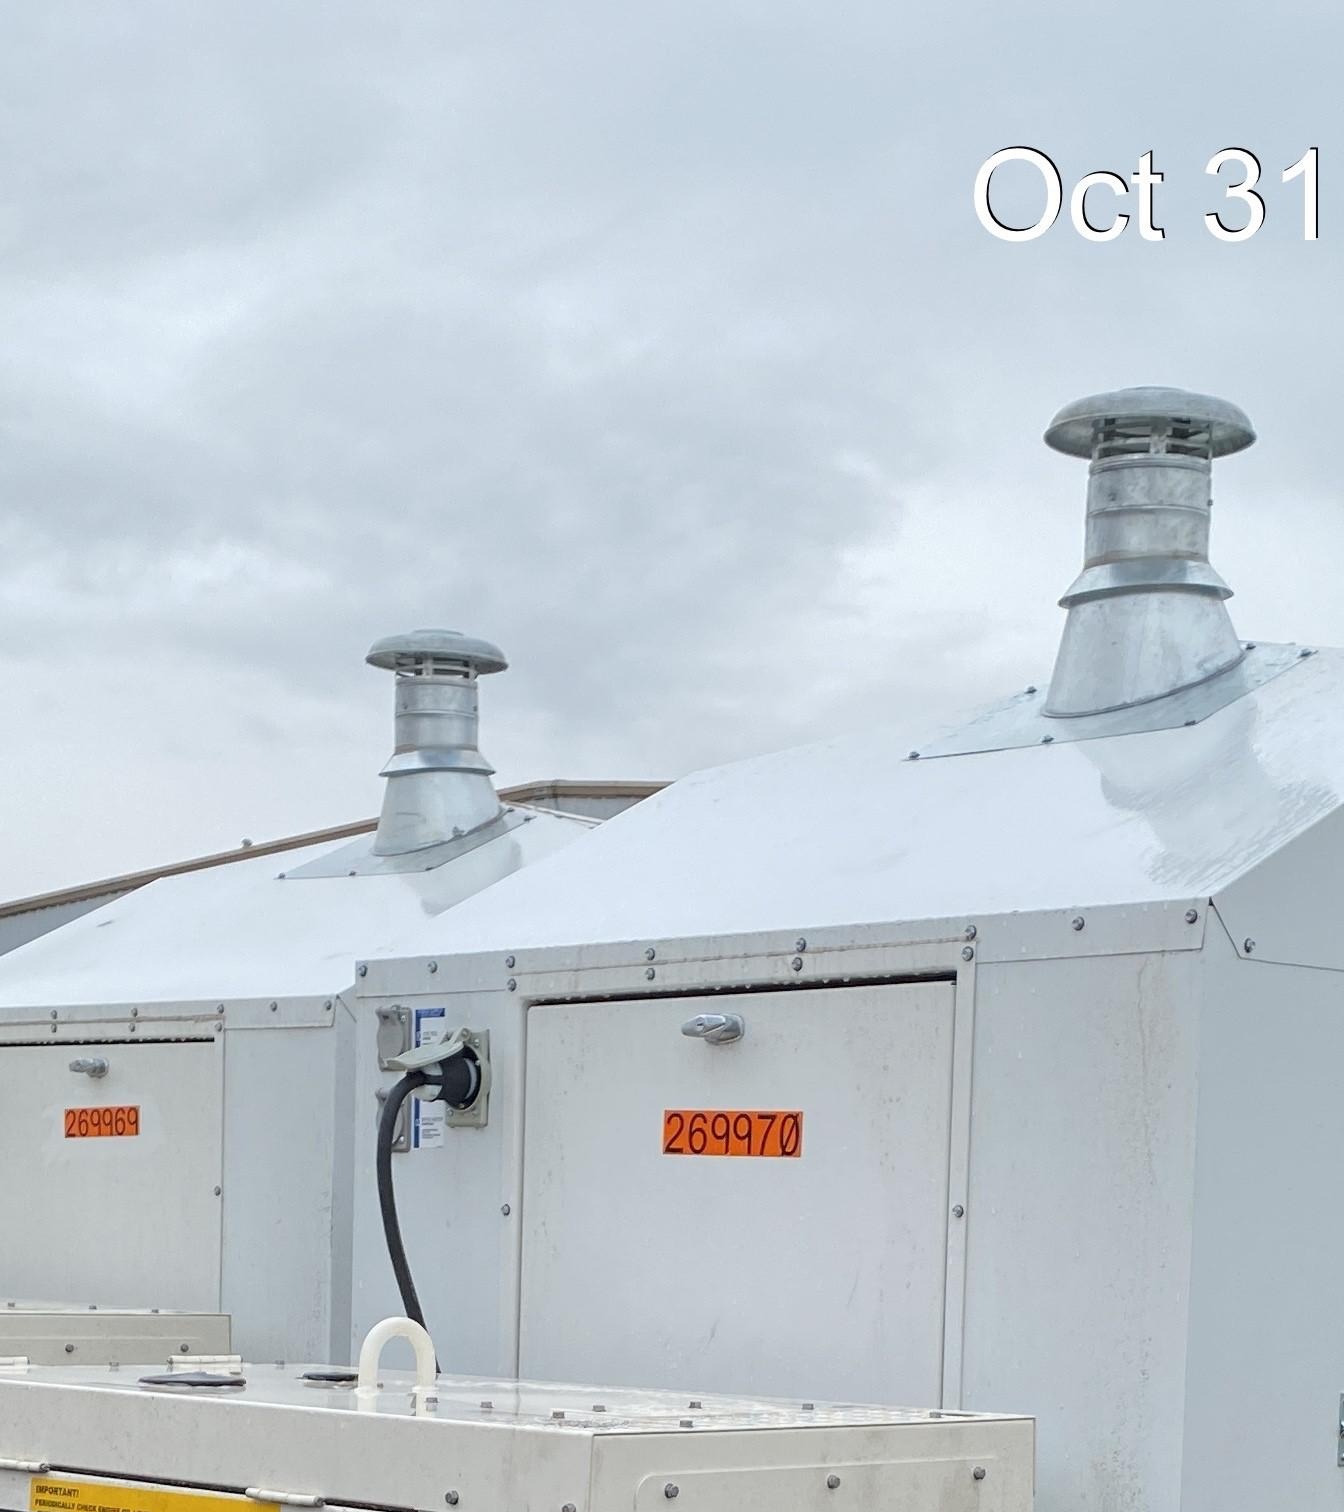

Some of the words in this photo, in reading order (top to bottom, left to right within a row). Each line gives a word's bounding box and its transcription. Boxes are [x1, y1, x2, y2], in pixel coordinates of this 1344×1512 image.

[64, 1107, 139, 1138] 269969
[665, 1112, 801, 1157] 269970
[35, 1485, 80, 1498] IMPORTANT!
[34, 1498, 76, 1511] PERIODICALLY
[76, 1503, 97, 1512] CHECK
